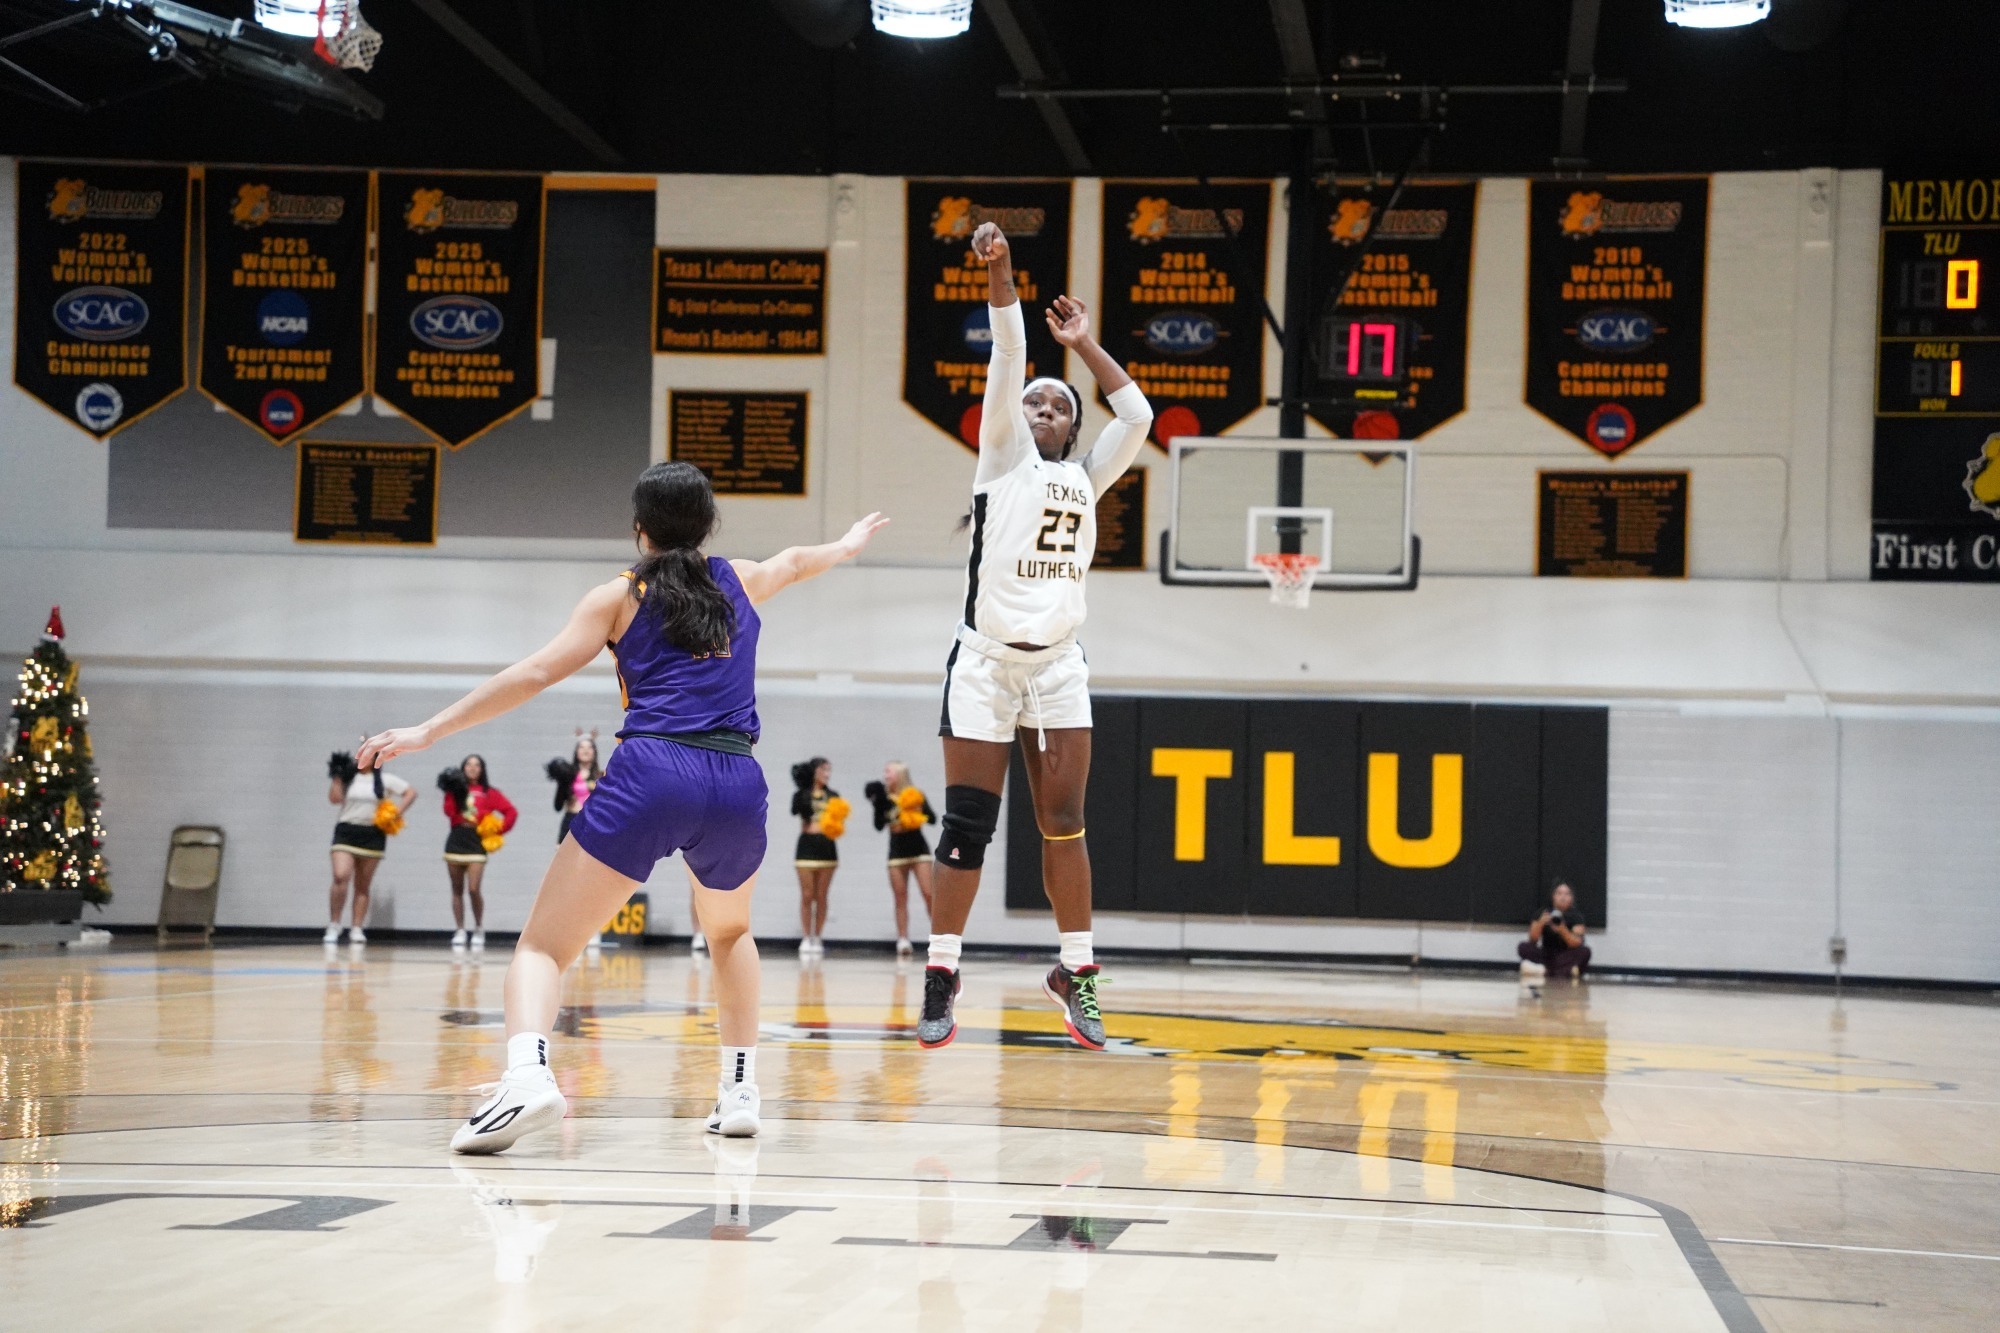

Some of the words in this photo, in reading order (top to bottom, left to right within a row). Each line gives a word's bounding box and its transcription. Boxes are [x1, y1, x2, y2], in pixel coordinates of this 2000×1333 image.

[80, 233, 127, 250] 2022
[1923, 232, 1961, 255] TLU
[59, 250, 147, 267] Women's
[241, 253, 328, 272] Women's
[1161, 253, 1207, 270] 2014
[1362, 254, 1409, 271] 2015
[1594, 247, 1643, 265] 2019
[53, 265, 152, 285] Volleyball
[415, 258, 501, 276] Women's
[1570, 264, 1663, 283] Women's
[232, 270, 336, 288] Basketball
[407, 275, 509, 293] Basketball
[1139, 268, 1228, 287] Women's
[1946, 259, 1979, 310] 0
[1130, 285, 1236, 304] Basketball
[1337, 288, 1438, 306] asketball
[1561, 281, 1673, 300] Basketball
[68, 301, 134, 325] SCAC
[425, 310, 489, 333] SCAC
[261, 316, 308, 333] NCAA
[1150, 321, 1215, 344] SCAC
[1581, 318, 1648, 342] SCAC
[47, 341, 150, 359] Conference
[227, 346, 331, 364] Tournament
[408, 350, 500, 366] Conference
[1347, 322, 1396, 377] 17
[1913, 343, 1960, 360] FOULS
[48, 359, 148, 377] Champions
[235, 364, 267, 381] 2nd
[272, 364, 327, 381] Round
[1557, 360, 1669, 379] Conference
[411, 382, 500, 398] Champions
[1558, 379, 1666, 397] Champions
[1044, 482, 1087, 506] TEXAS
[1036, 508, 1082, 553] 23
[1875, 533, 1959, 570] First
[1972, 534, 2000, 570] C
[1151, 748, 1463, 869] TLU
